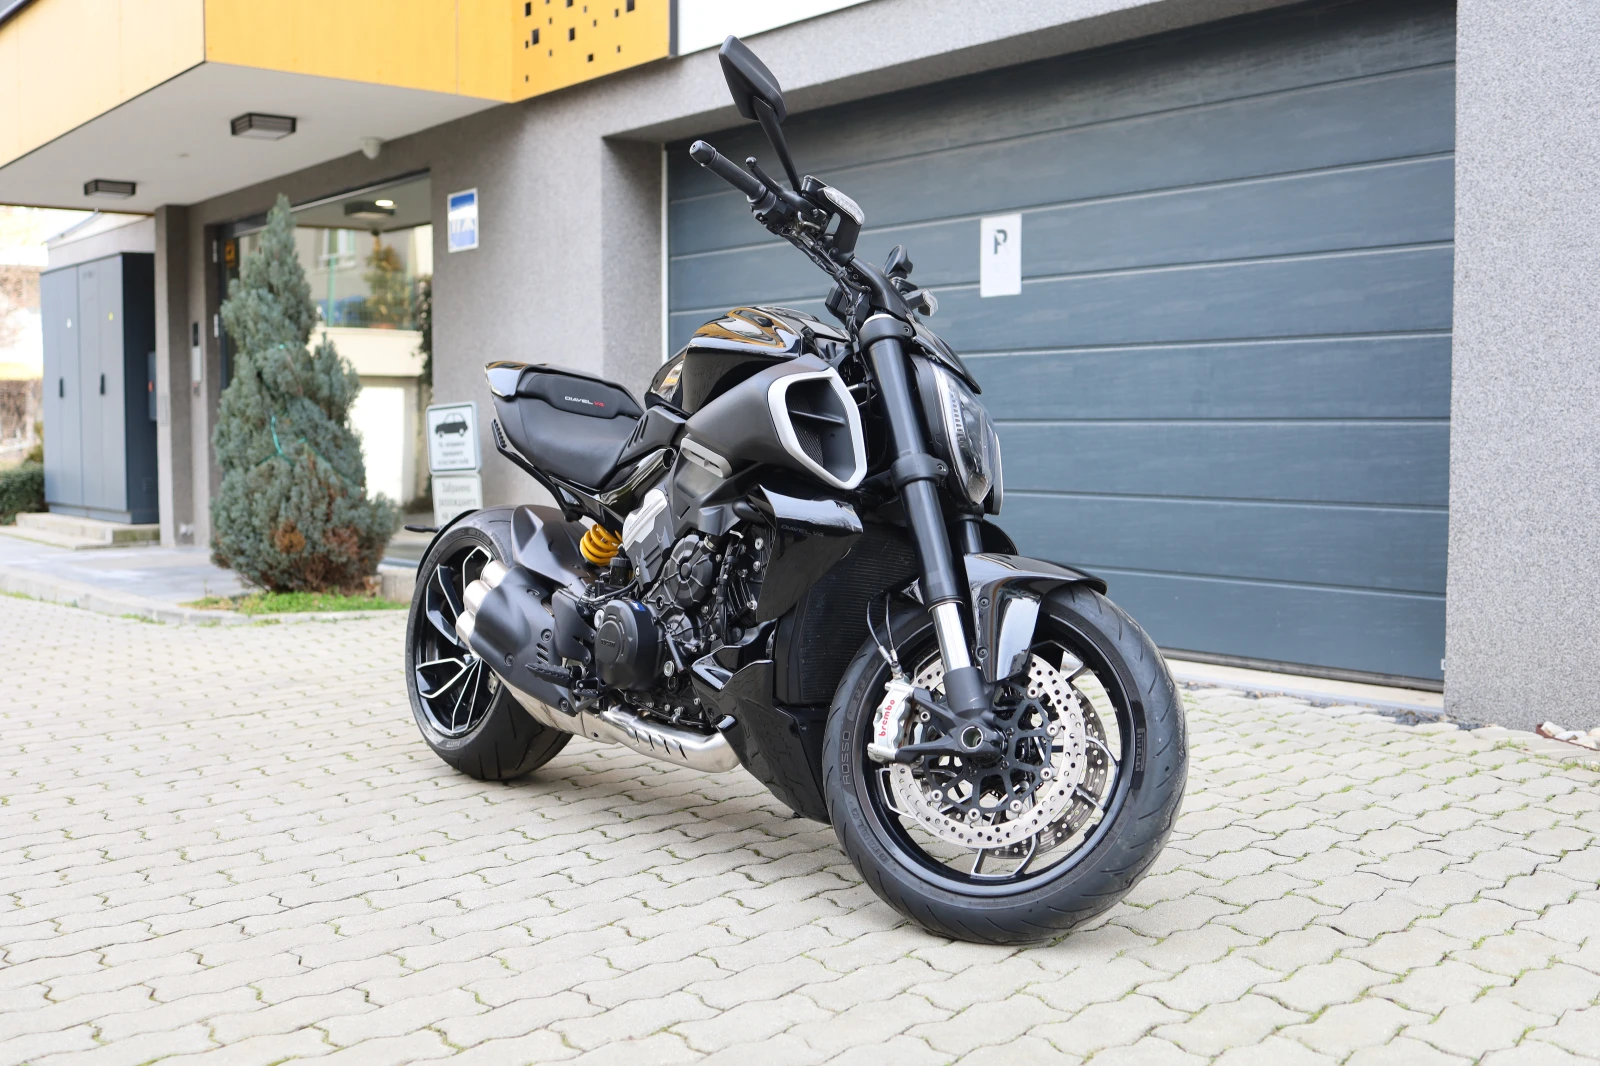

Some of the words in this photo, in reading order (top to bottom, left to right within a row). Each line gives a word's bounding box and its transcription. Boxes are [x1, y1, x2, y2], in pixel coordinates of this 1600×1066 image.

[564, 396, 594, 405] DIAVEL
[781, 524, 811, 535] DIAVEL
[879, 699, 895, 737] brembo
[841, 730, 851, 785] ROSSO
